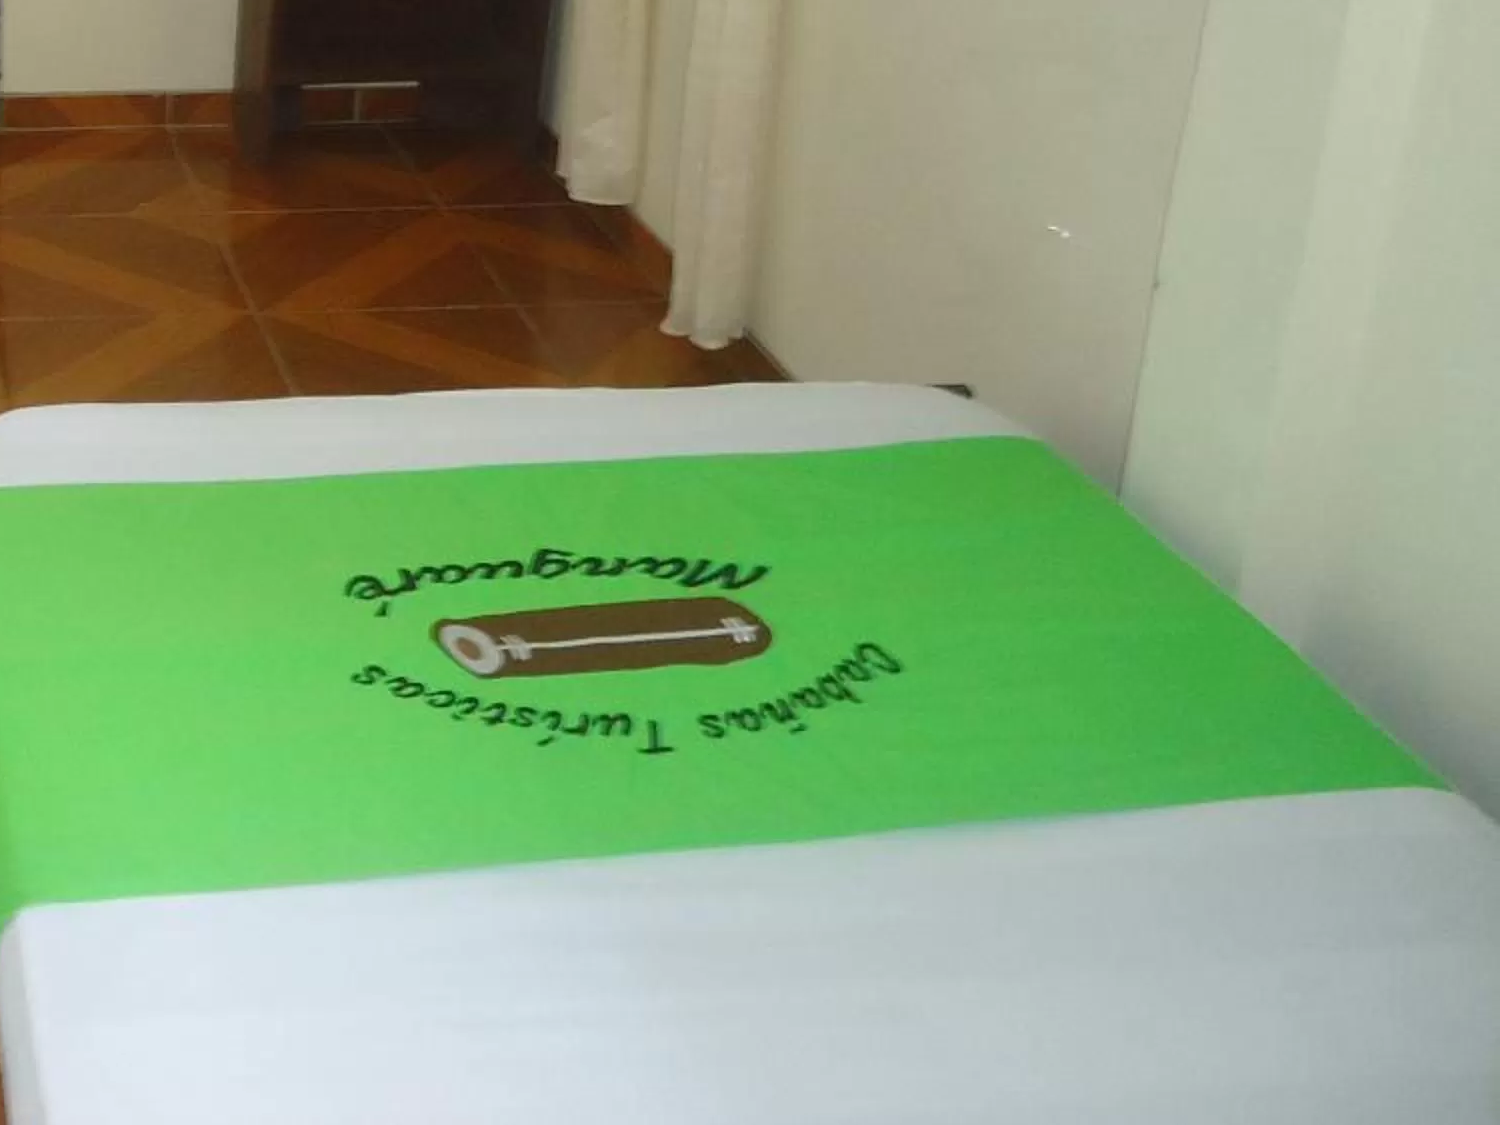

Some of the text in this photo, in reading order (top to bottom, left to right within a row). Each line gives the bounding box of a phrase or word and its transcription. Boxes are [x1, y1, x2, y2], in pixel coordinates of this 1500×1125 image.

[343, 547, 772, 618] Manguaré
[350, 641, 905, 754] Cabañas Turísticas
